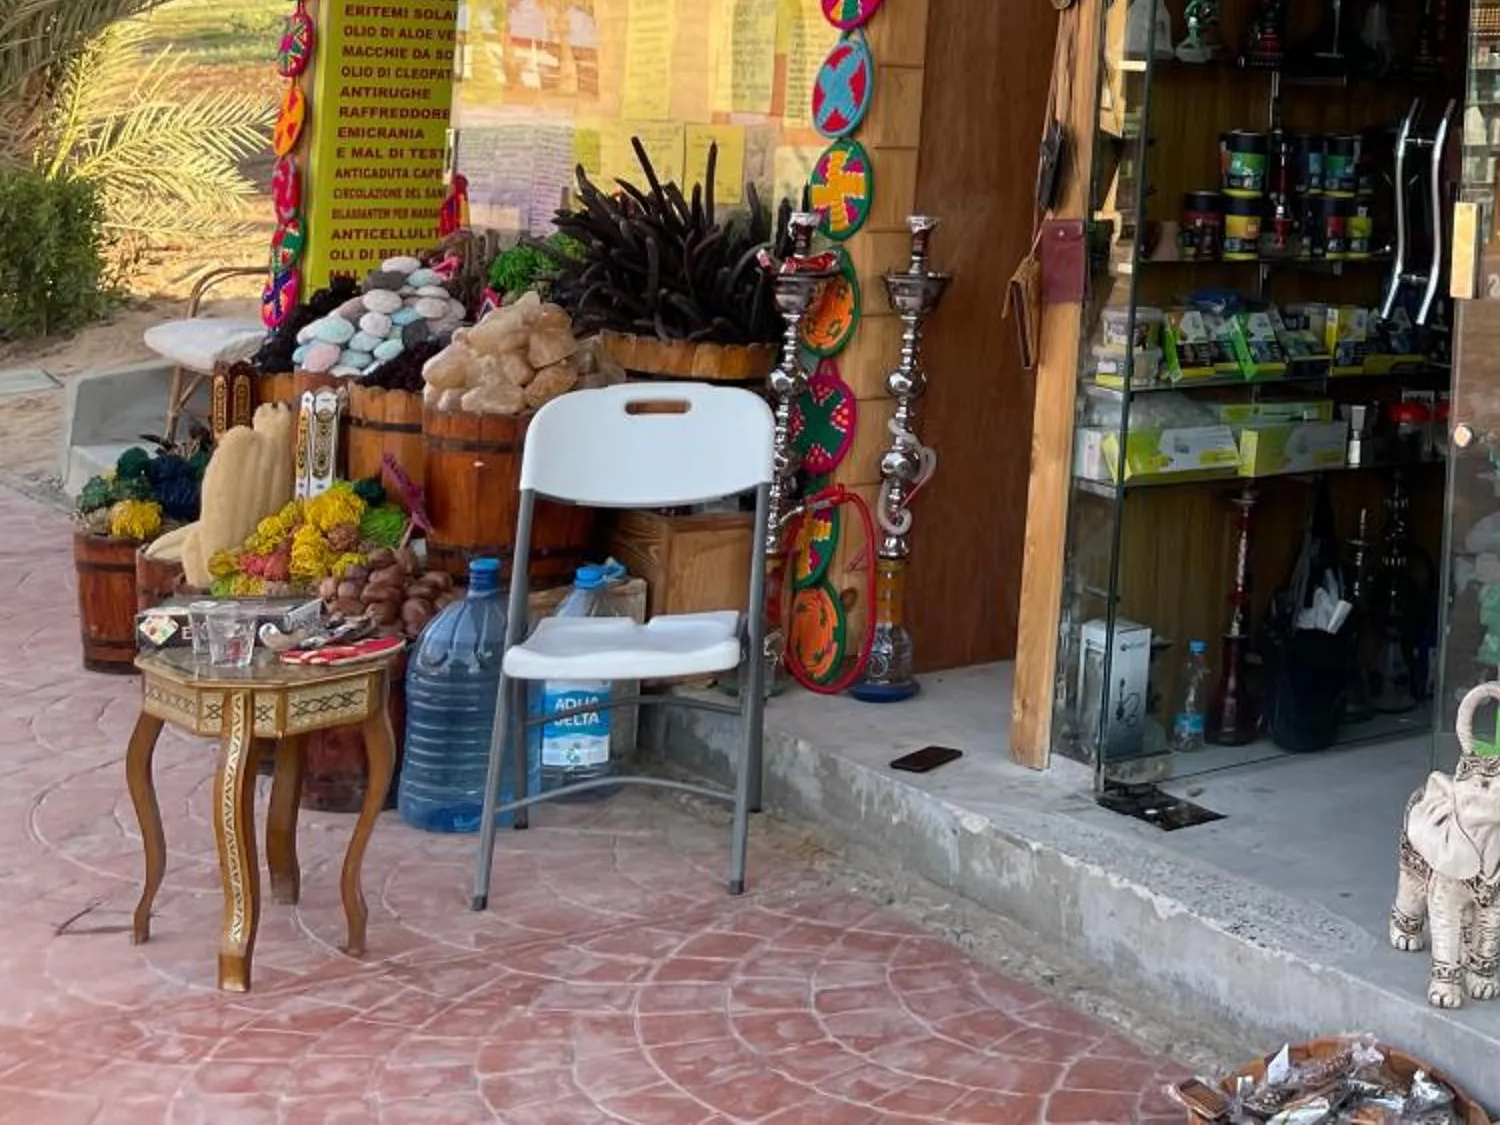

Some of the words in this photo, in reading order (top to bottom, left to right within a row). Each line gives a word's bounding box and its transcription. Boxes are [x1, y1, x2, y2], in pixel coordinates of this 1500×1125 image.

[343, 25, 377, 38] OLIO
[381, 26, 395, 38] DI
[399, 28, 434, 40] ALOE
[342, 46, 408, 59] MACCHIE
[413, 49, 431, 60] DA
[341, 66, 375, 78] OLIO
[378, 67, 391, 78] DI
[340, 86, 431, 100] ANTIRUGHE
[337, 127, 425, 140] EMICRANIA
[336, 147, 346, 159] E
[351, 147, 383, 159] MAL
[389, 148, 404, 160] DI
[329, 248, 355, 261] OLI
[359, 248, 374, 260] DI
[554, 712, 600, 727] ELTA
